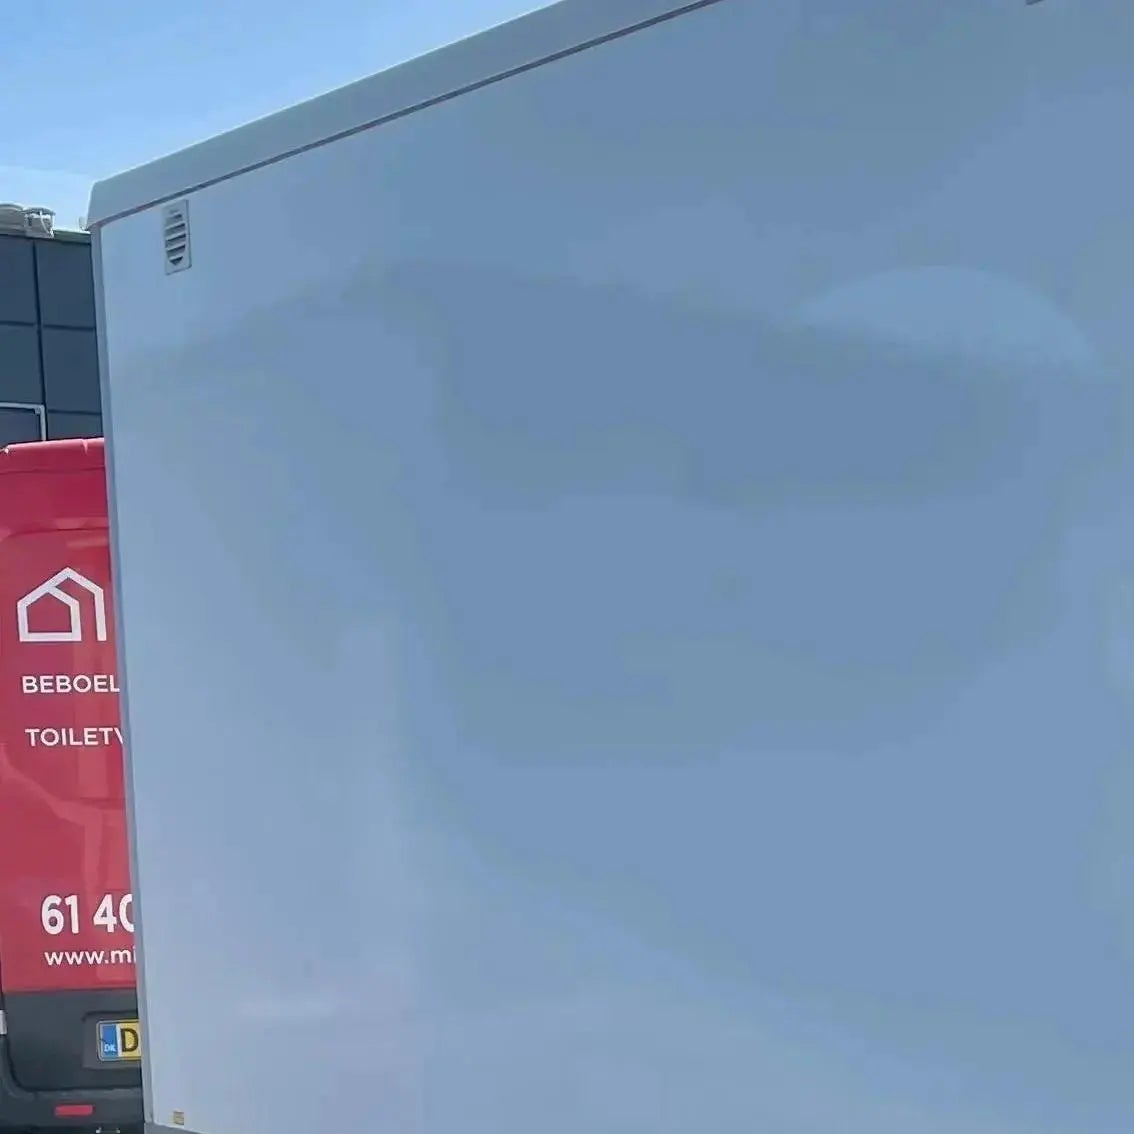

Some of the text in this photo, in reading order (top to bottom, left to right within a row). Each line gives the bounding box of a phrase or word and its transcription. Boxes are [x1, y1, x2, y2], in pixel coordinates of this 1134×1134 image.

[22, 675, 120, 693] BEBOEL
[42, 894, 79, 935] 61
[121, 1028, 139, 1052] D
